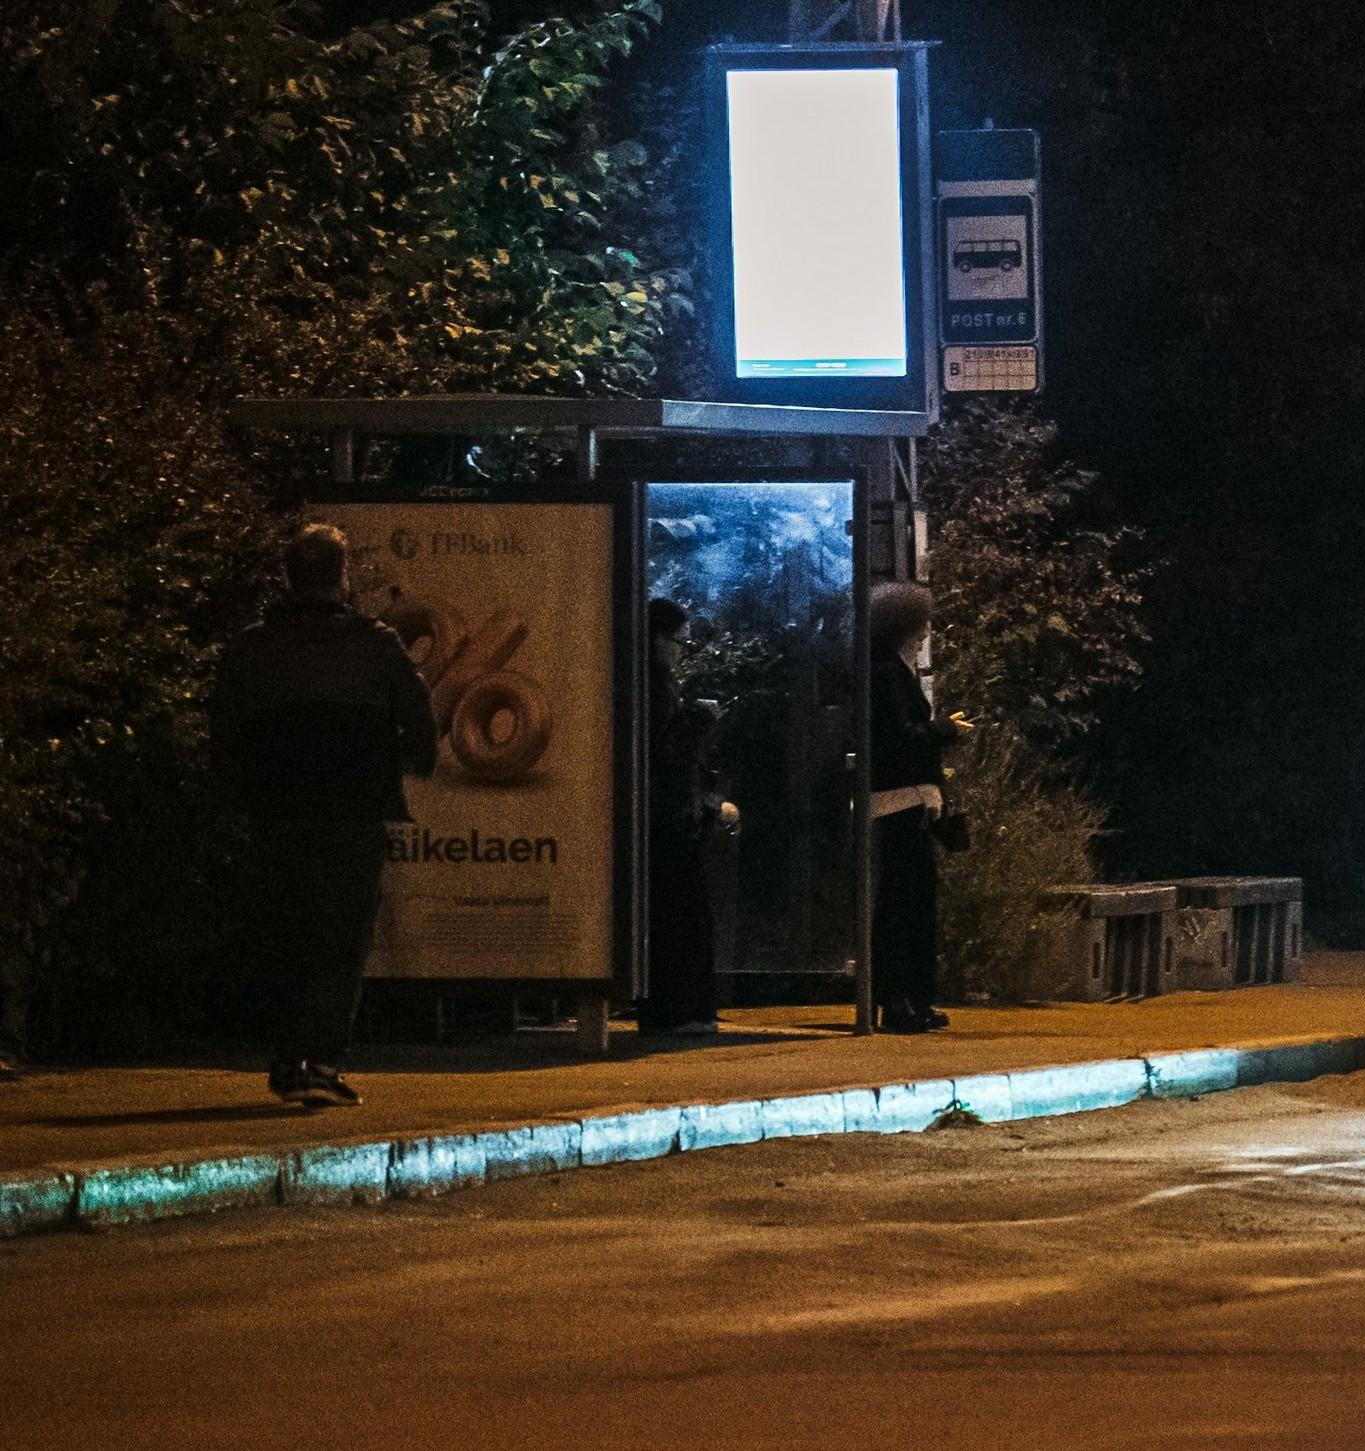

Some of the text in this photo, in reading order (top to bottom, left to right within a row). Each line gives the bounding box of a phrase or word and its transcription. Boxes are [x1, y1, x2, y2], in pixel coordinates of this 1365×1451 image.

[951, 313, 993, 328] POST
[950, 362, 960, 376] B
[386, 829, 558, 864] äikelaen
